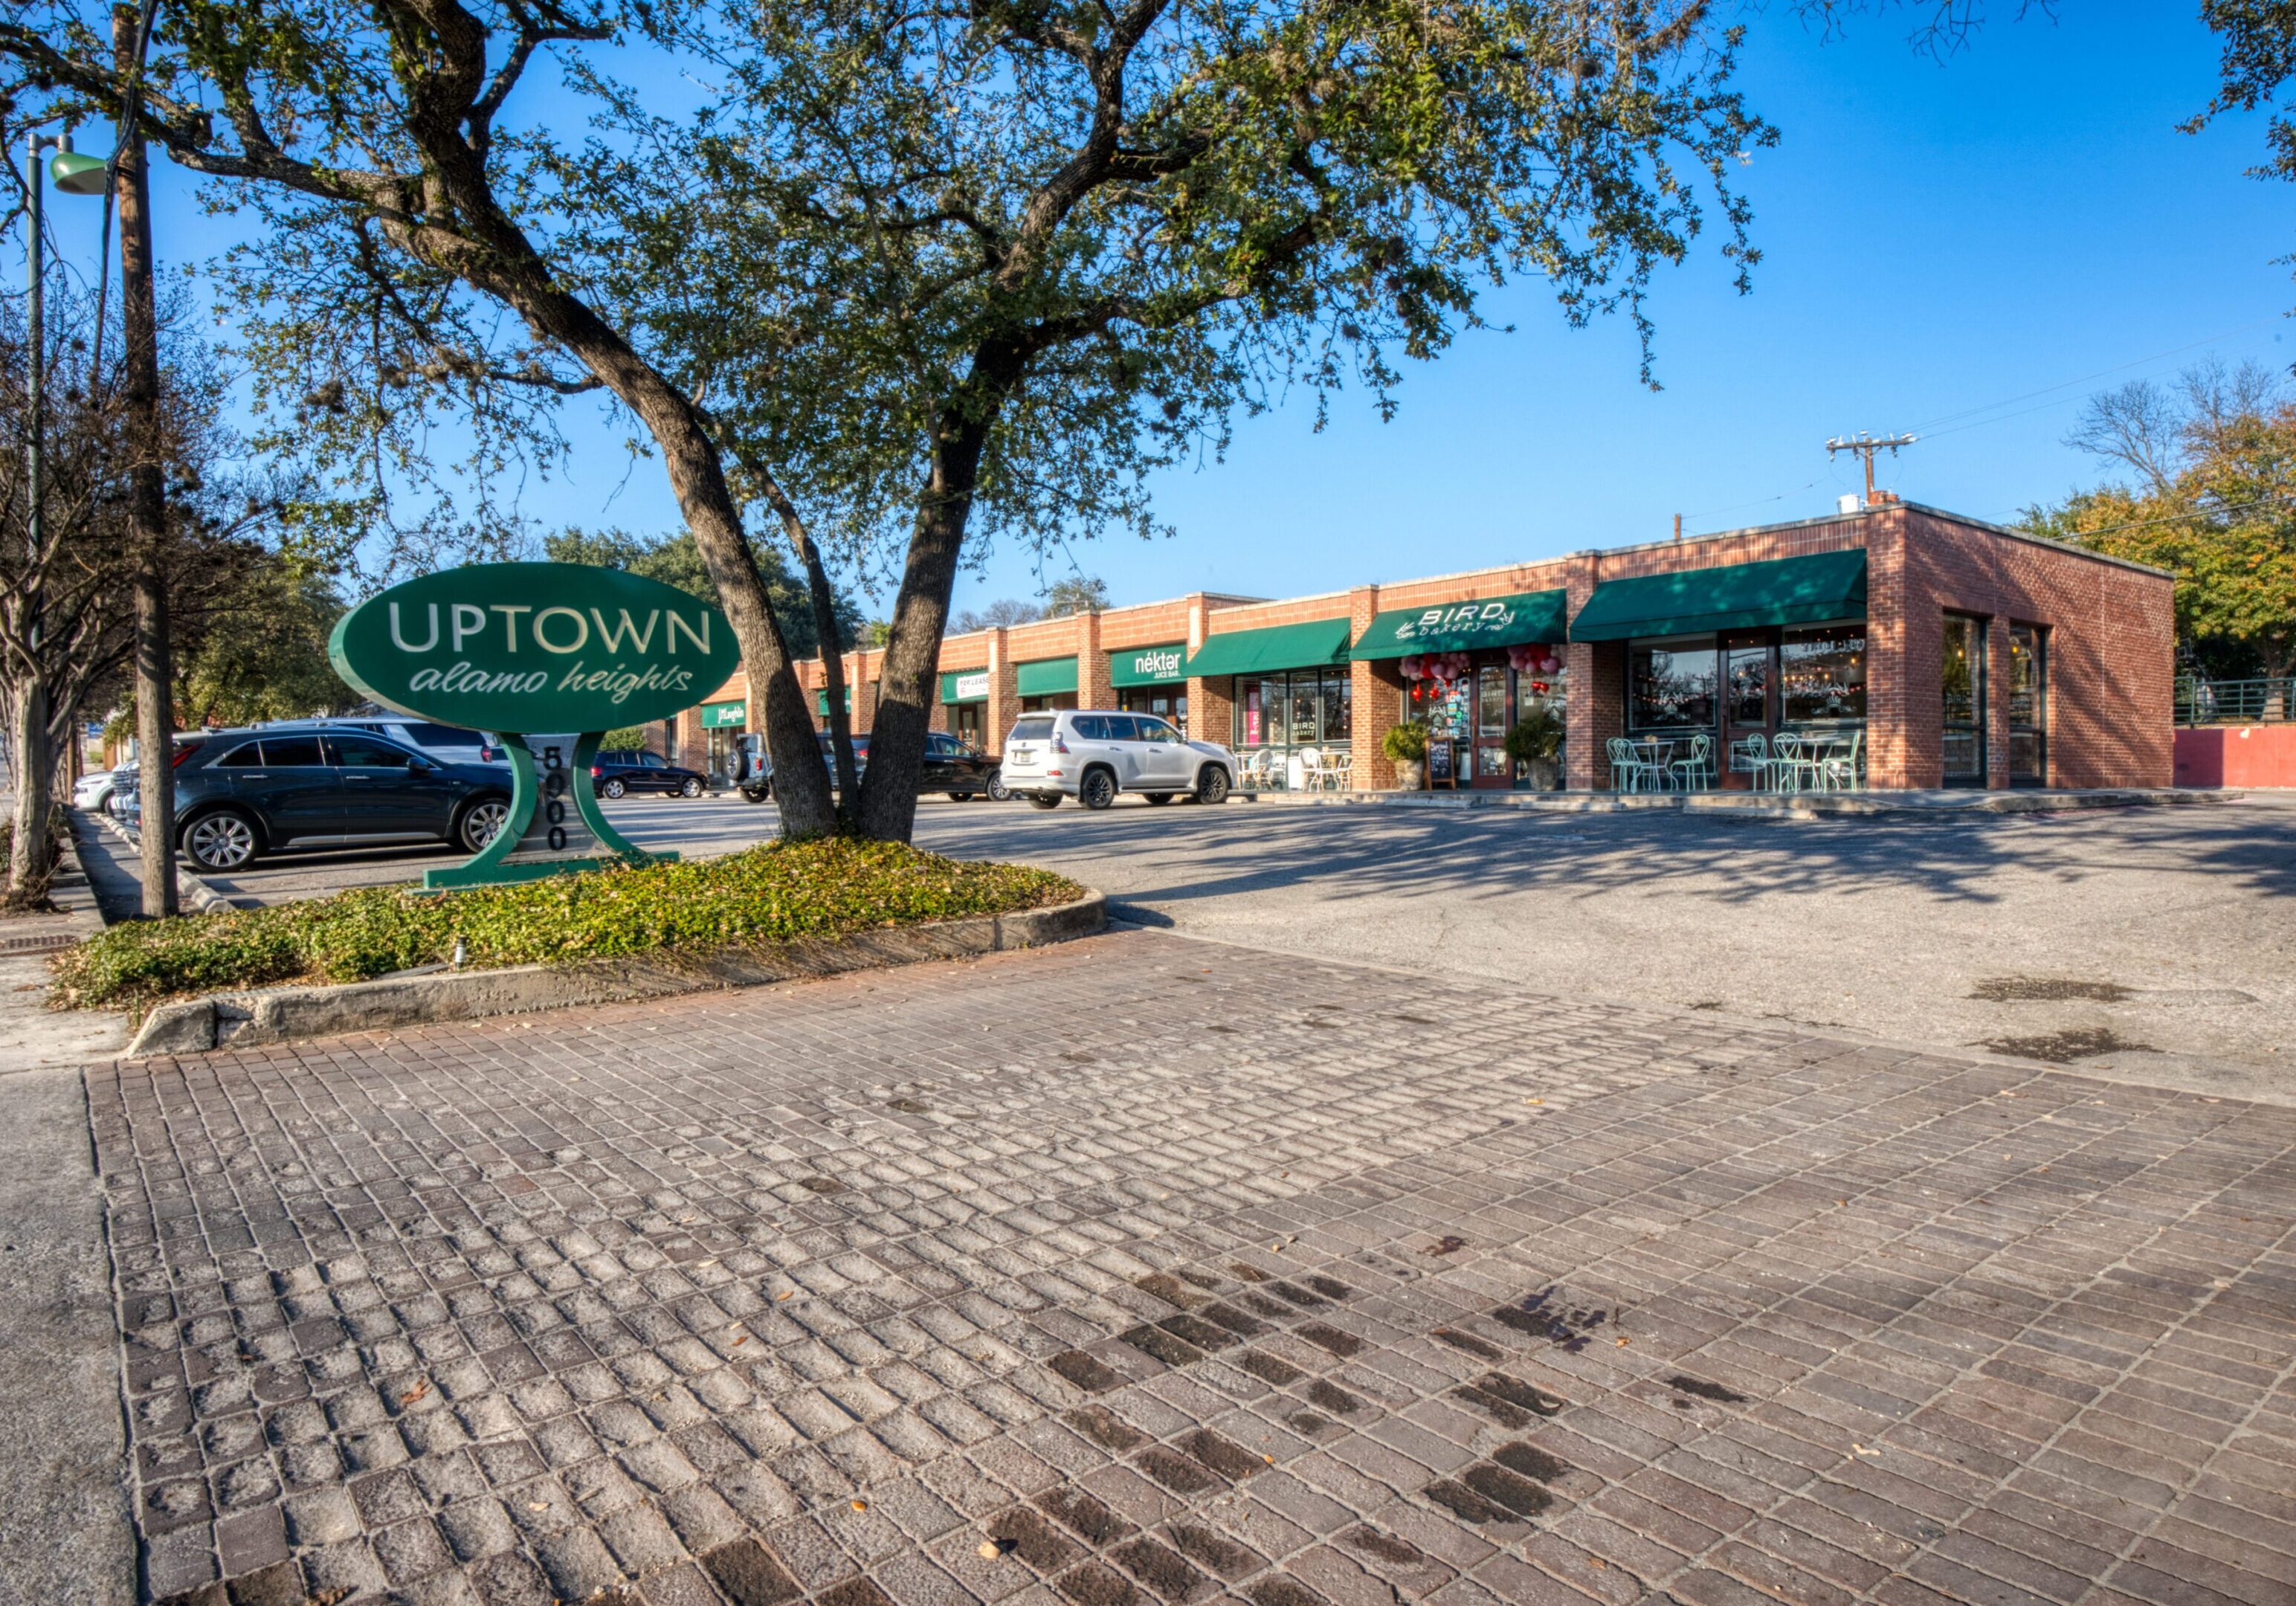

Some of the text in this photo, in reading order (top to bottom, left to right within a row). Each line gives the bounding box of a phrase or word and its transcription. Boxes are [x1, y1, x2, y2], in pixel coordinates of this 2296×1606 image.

[1418, 602, 1505, 626] BIRD
[389, 602, 711, 655] UPTOWN
[1419, 621, 1486, 636] bakery
[409, 661, 693, 704] alamo heights
[1292, 721, 1315, 730] BIRD
